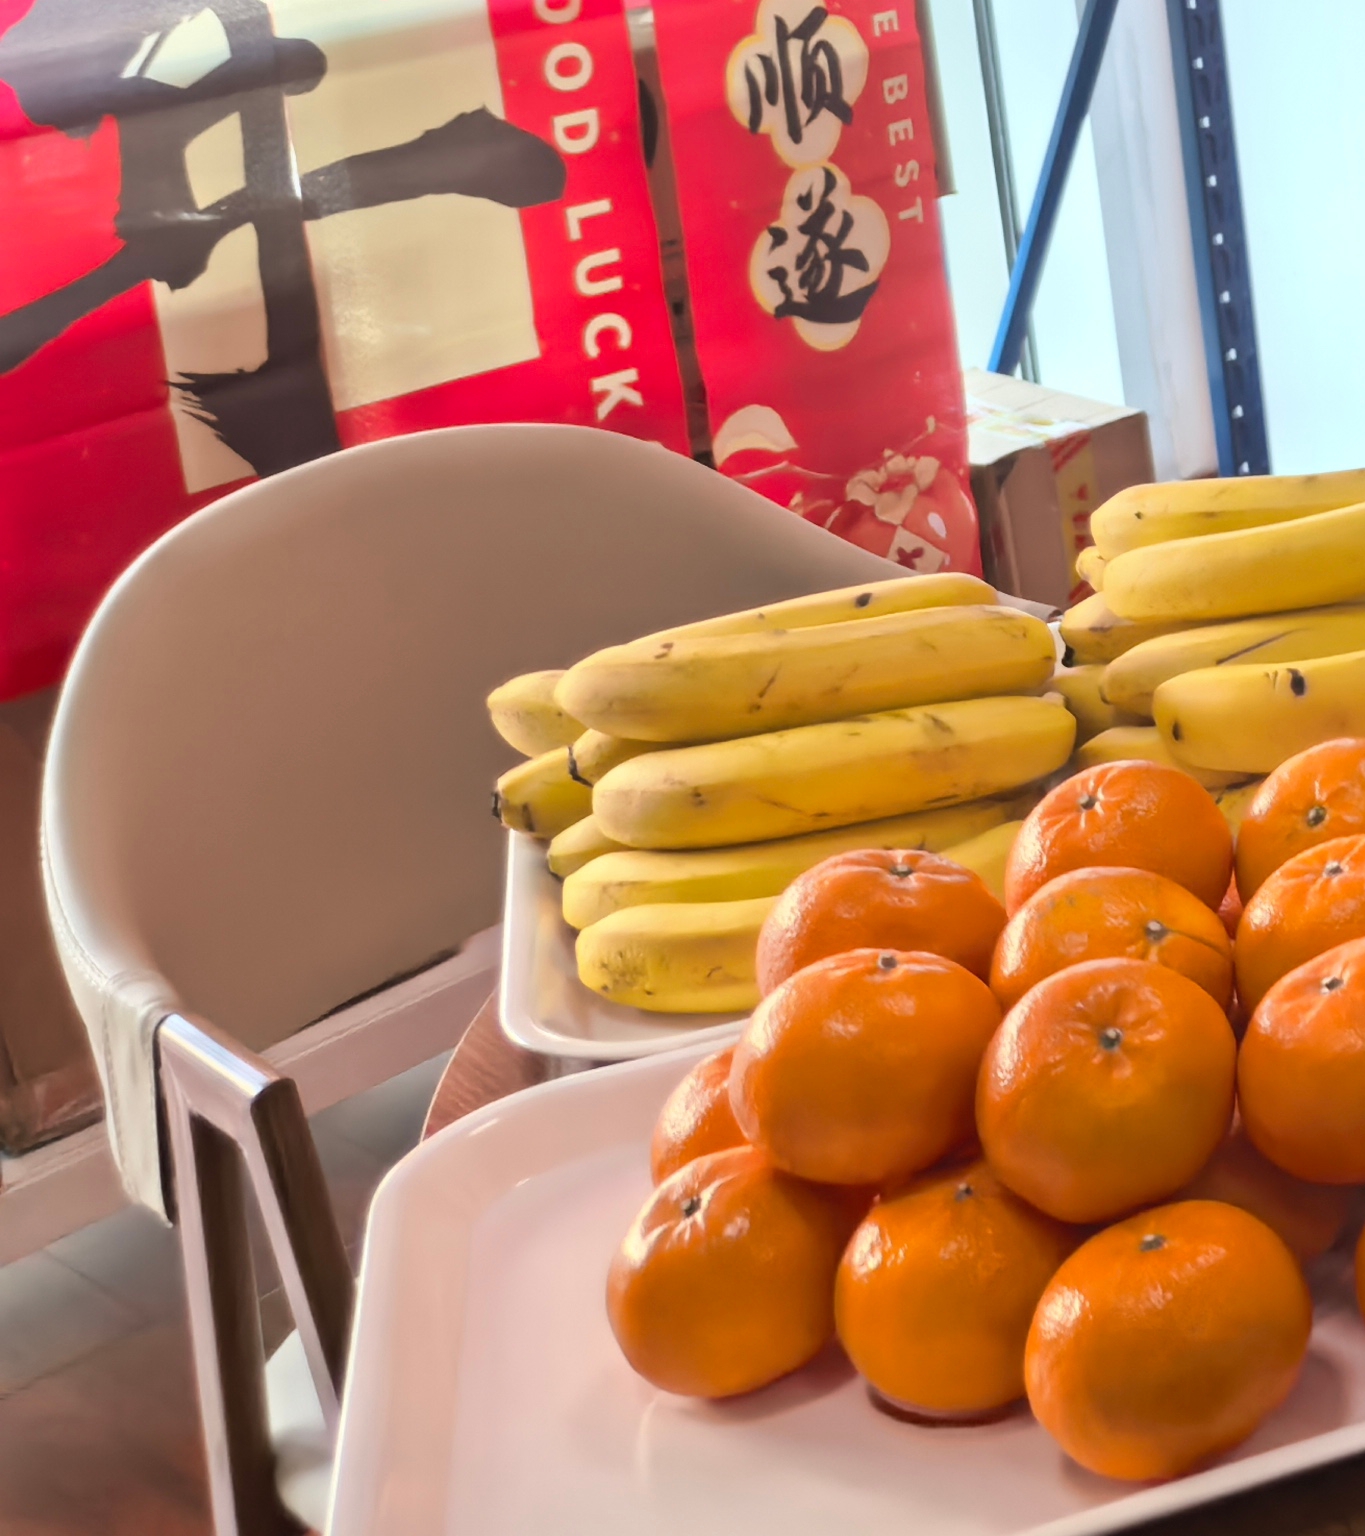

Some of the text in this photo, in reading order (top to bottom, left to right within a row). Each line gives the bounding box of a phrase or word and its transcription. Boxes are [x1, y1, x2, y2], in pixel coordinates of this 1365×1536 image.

[744, 5, 880, 325] 顺遂
[881, 73, 924, 225] BEST
[563, 196, 645, 422] LUCK
